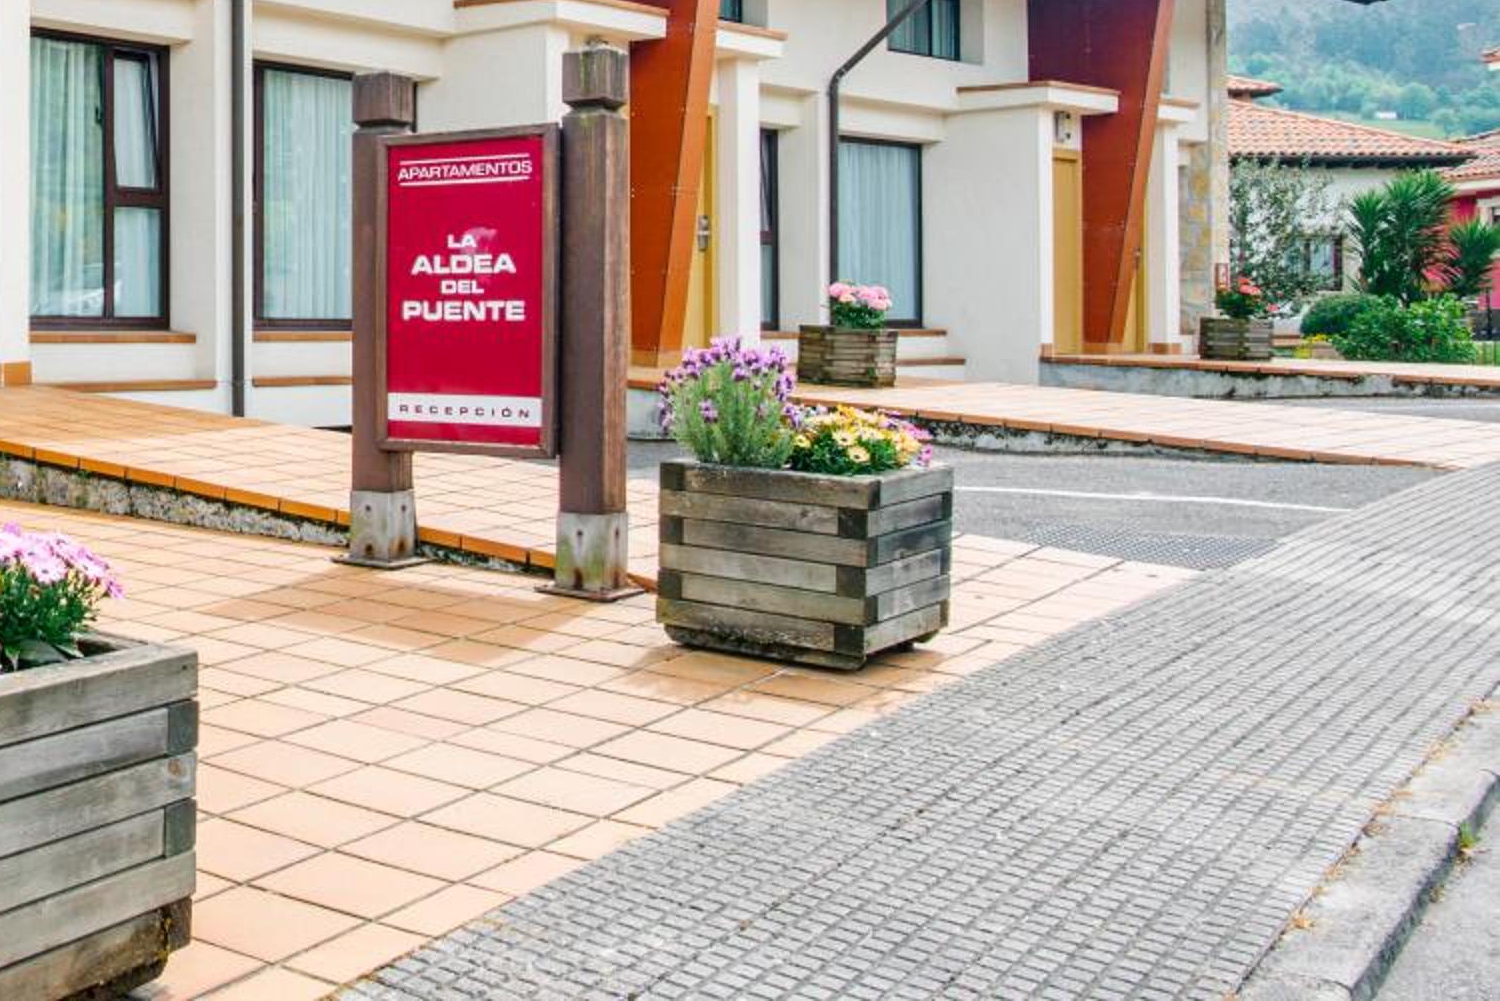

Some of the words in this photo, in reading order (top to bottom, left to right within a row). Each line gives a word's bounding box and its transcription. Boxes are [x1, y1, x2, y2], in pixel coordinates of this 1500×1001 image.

[397, 160, 532, 181] APARTAMENTOS
[447, 234, 476, 248] LA
[411, 253, 516, 275] ALDEA
[441, 280, 484, 295] DEL
[402, 300, 525, 321] PUENTE
[399, 404, 530, 419] RECEPCIÓN
